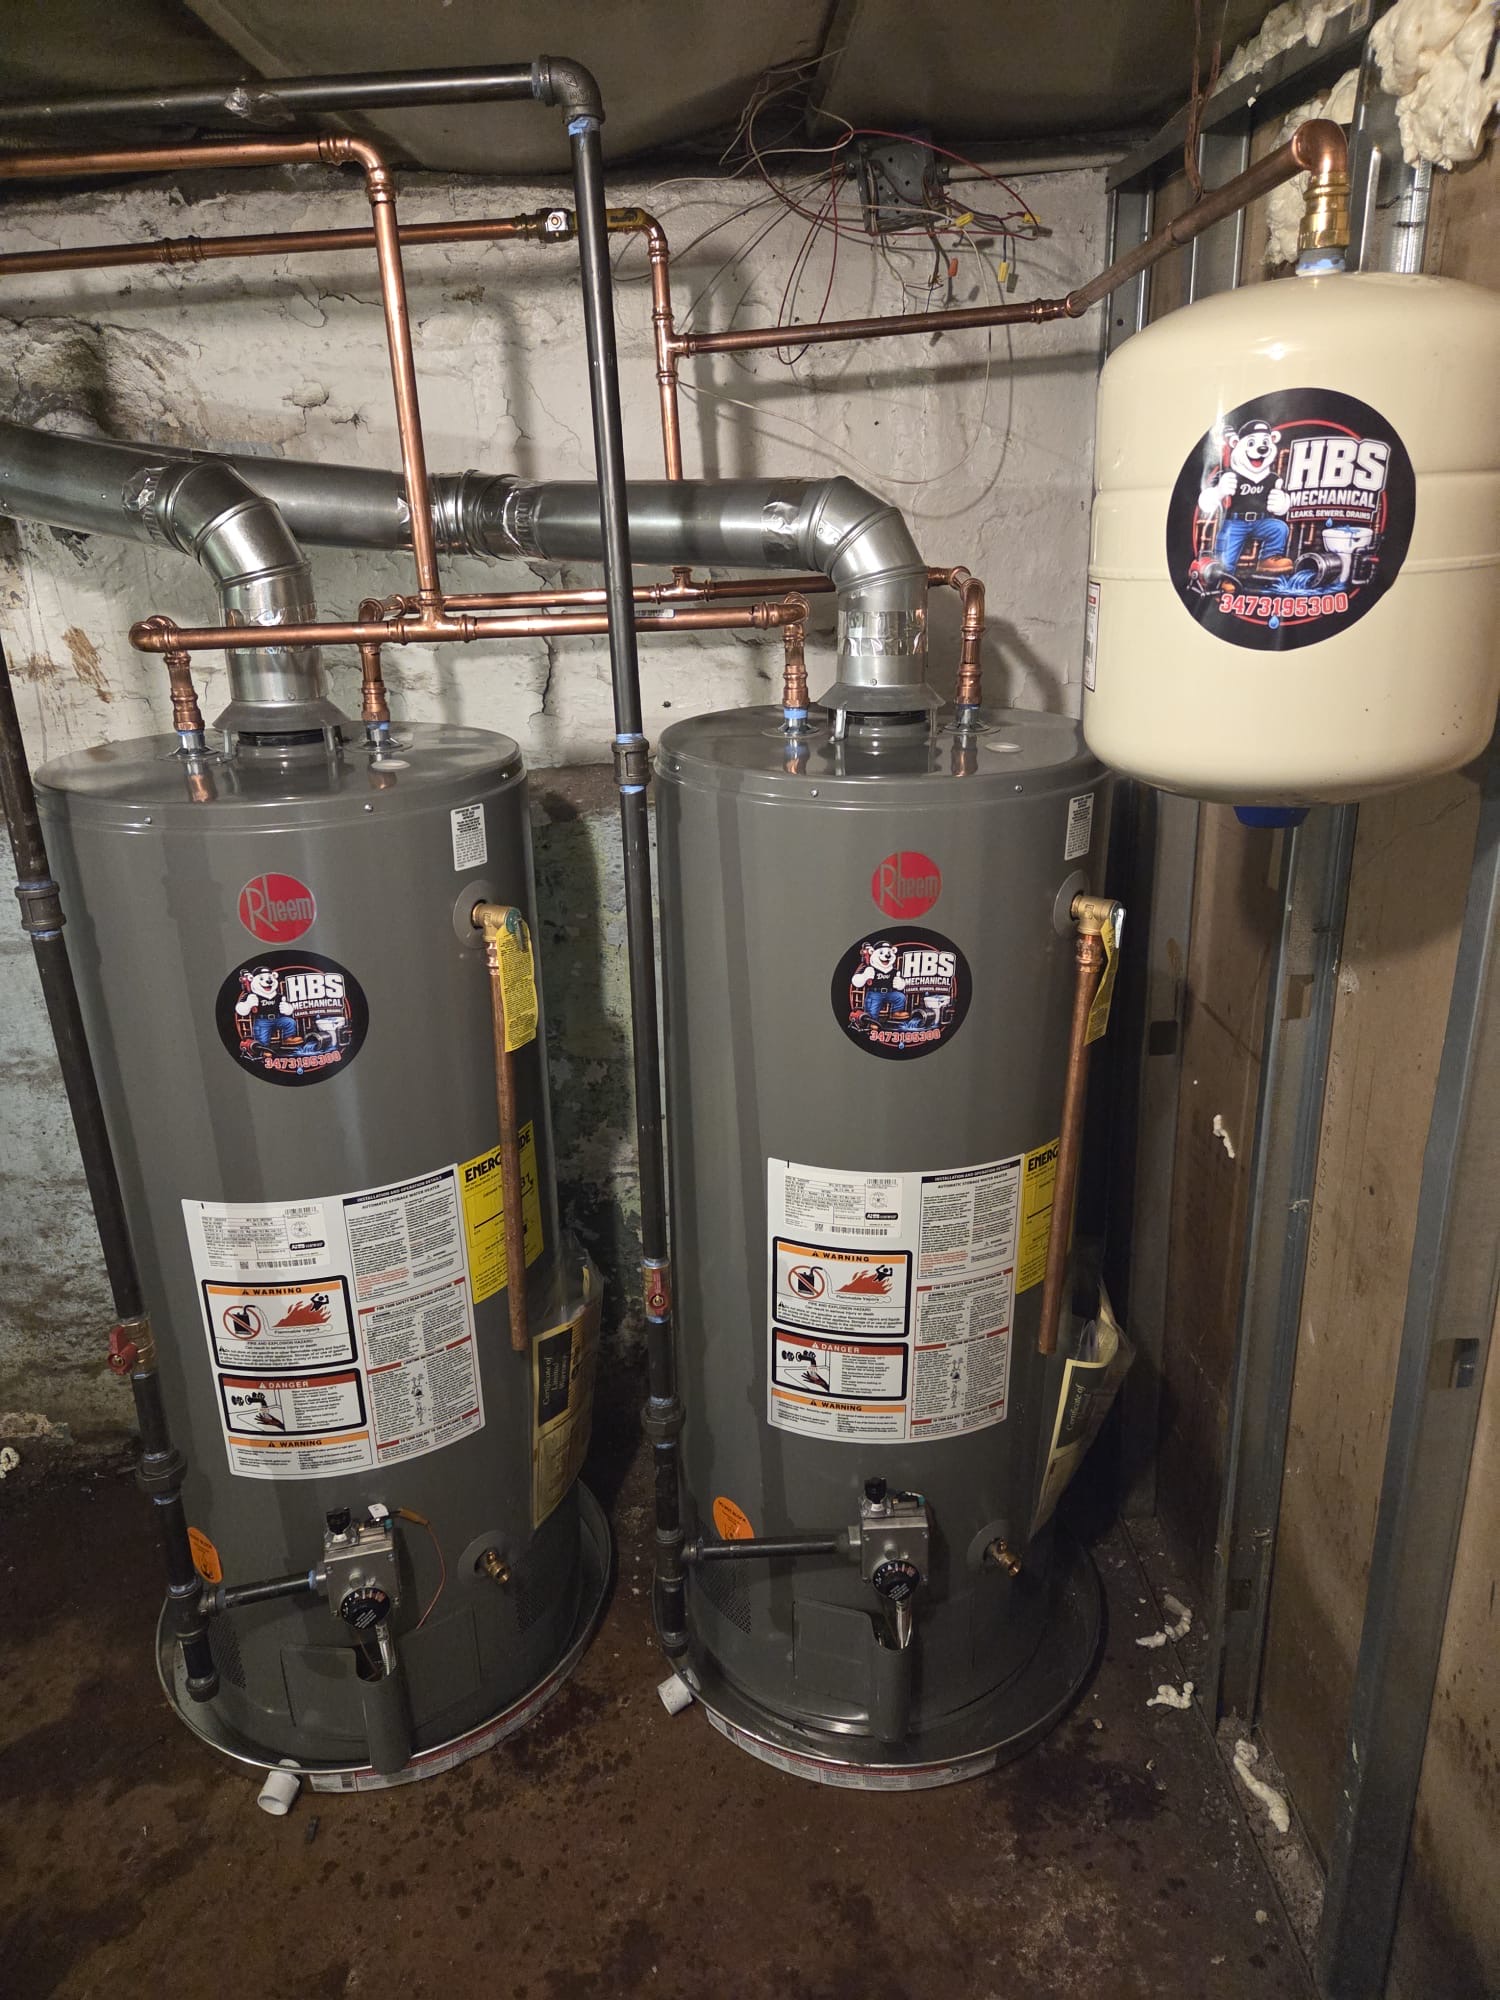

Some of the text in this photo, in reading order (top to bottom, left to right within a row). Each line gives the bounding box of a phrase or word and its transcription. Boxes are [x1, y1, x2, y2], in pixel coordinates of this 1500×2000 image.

[1288, 438, 1389, 492] HBS
[1239, 482, 1264, 496] Dov
[1289, 489, 1376, 509] MECHANICAL
[1290, 510, 1315, 519] LEAKS,
[1219, 592, 1348, 618] 3473195300
[879, 853, 938, 909] Rheem
[245, 875, 313, 932] Rheem
[904, 952, 955, 978] HBS
[287, 974, 345, 1000] HBS
[905, 977, 950, 986] MECHANICAL
[292, 998, 343, 1009] MECHANICAL
[822, 1252, 870, 1262] WARNING
[253, 1288, 302, 1296] WARNING
[822, 1343, 860, 1354] DANGER
[268, 1380, 309, 1389] DANGER
[822, 1402, 862, 1412] WARNING
[280, 1440, 322, 1448] WARNING
